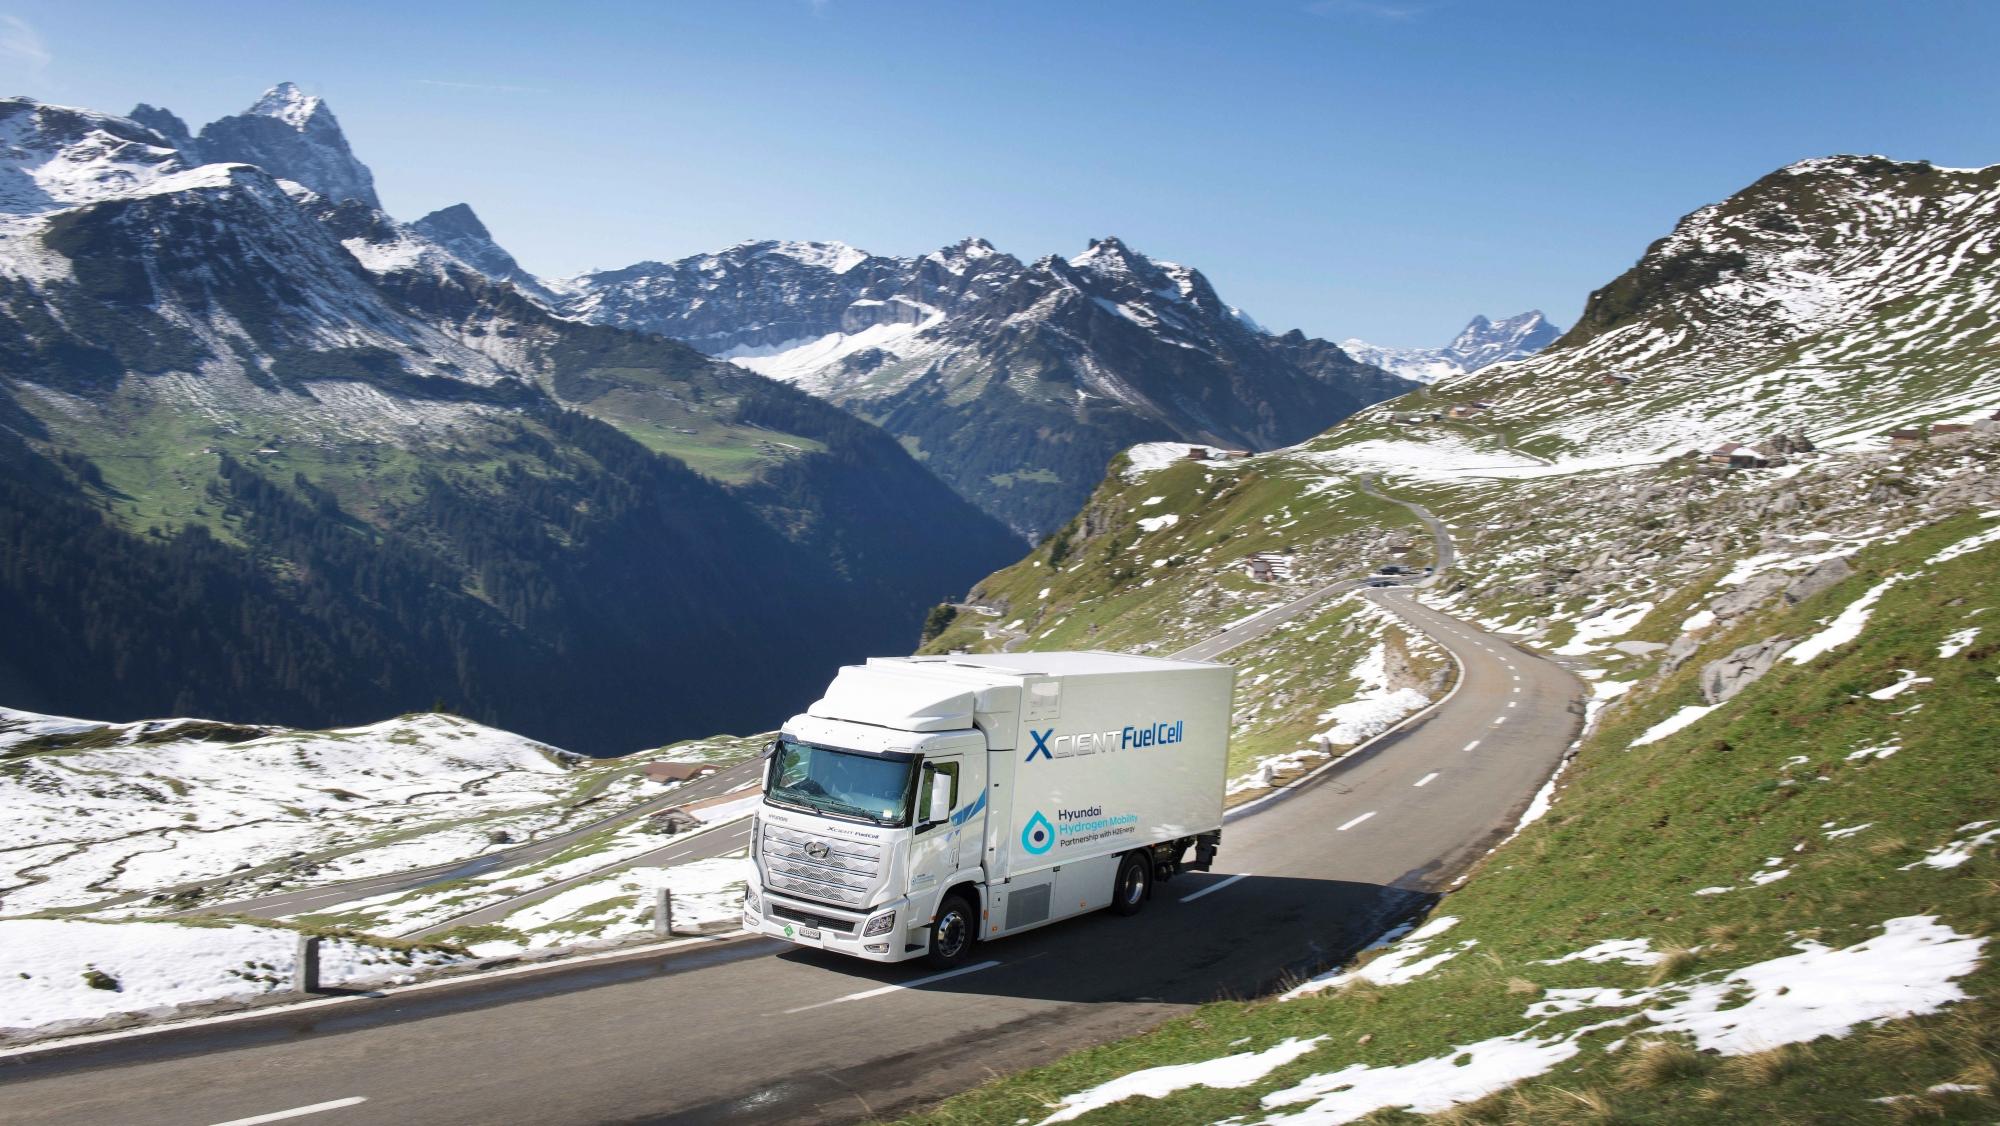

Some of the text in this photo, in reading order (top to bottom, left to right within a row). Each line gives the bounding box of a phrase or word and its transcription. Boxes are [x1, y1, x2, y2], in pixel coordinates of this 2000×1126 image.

[1025, 727, 1121, 762] XCIENT
[1058, 806, 1102, 822] Hyundai
[1059, 814, 1138, 835] Hydrogen Mobility
[1060, 826, 1135, 847] Partnership with H2Energy
